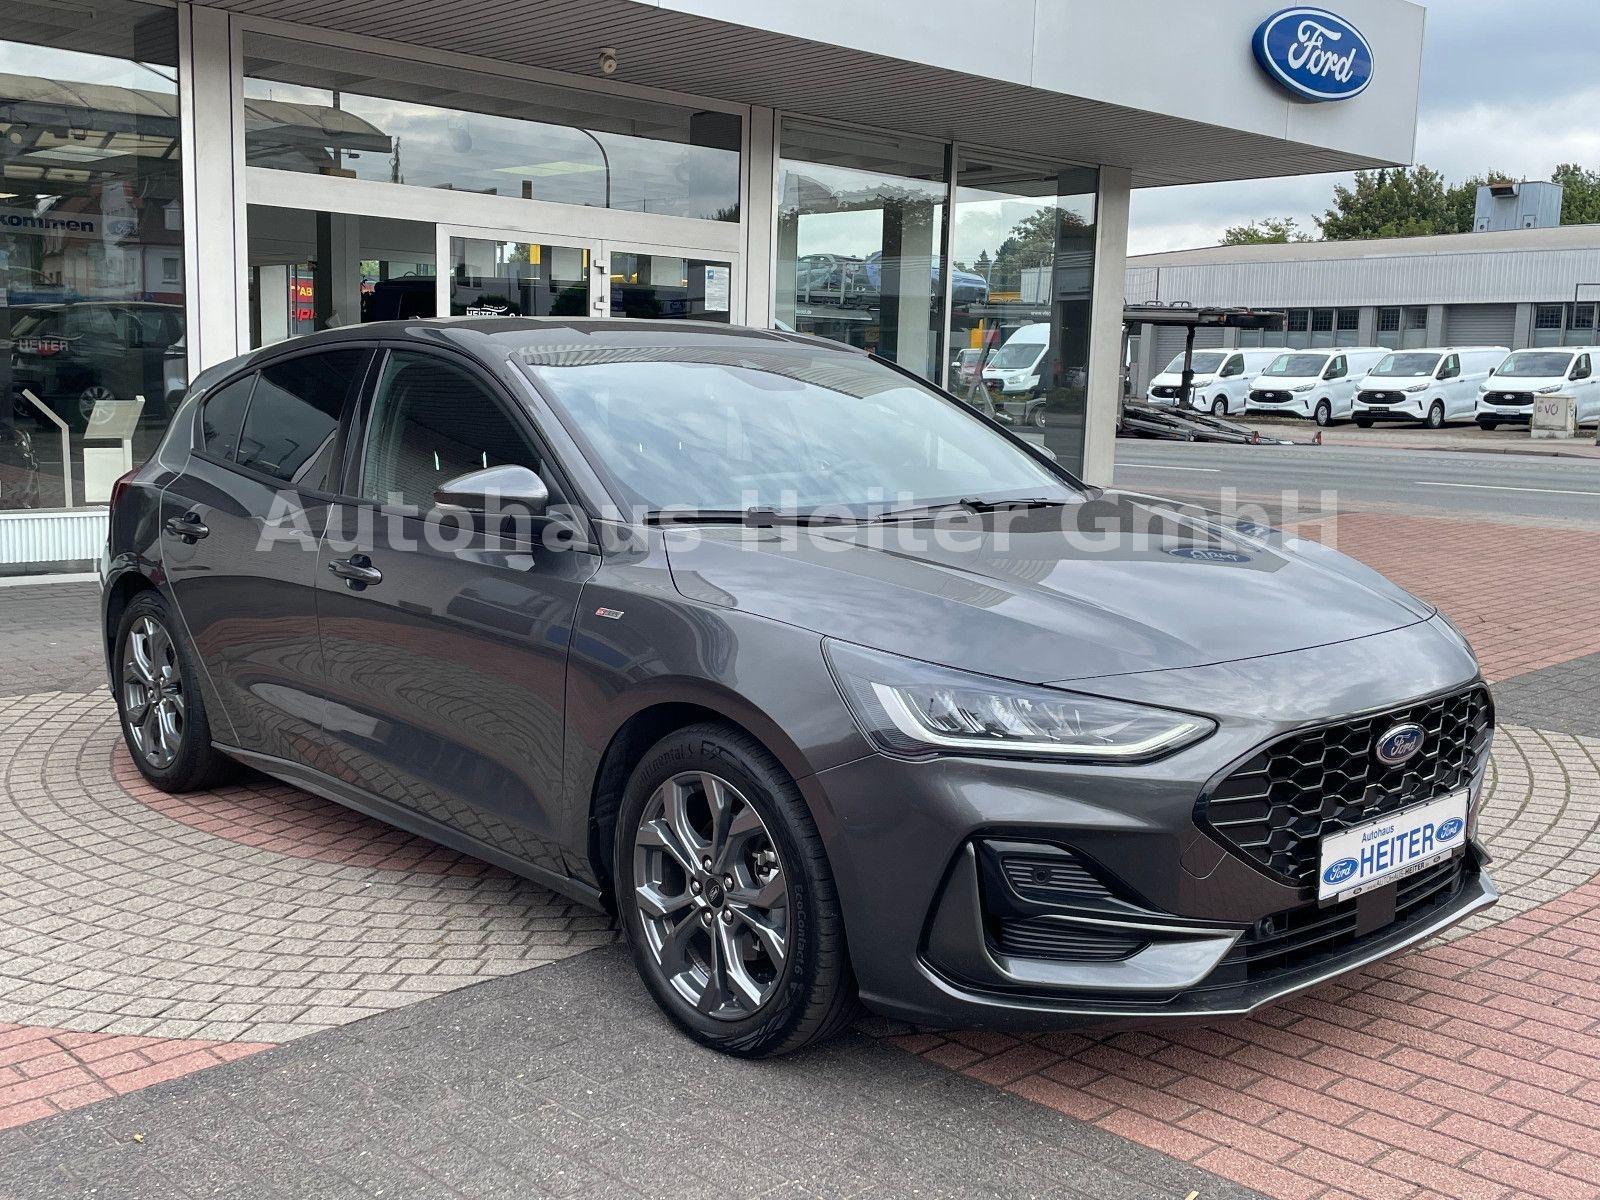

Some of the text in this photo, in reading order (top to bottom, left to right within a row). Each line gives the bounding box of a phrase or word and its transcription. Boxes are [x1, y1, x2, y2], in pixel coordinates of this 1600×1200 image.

[1287, 20, 1357, 84] Ford
[1390, 733, 1417, 757] Ford
[1360, 822, 1435, 879] HEITER
[1361, 824, 1395, 844] Autohaus
